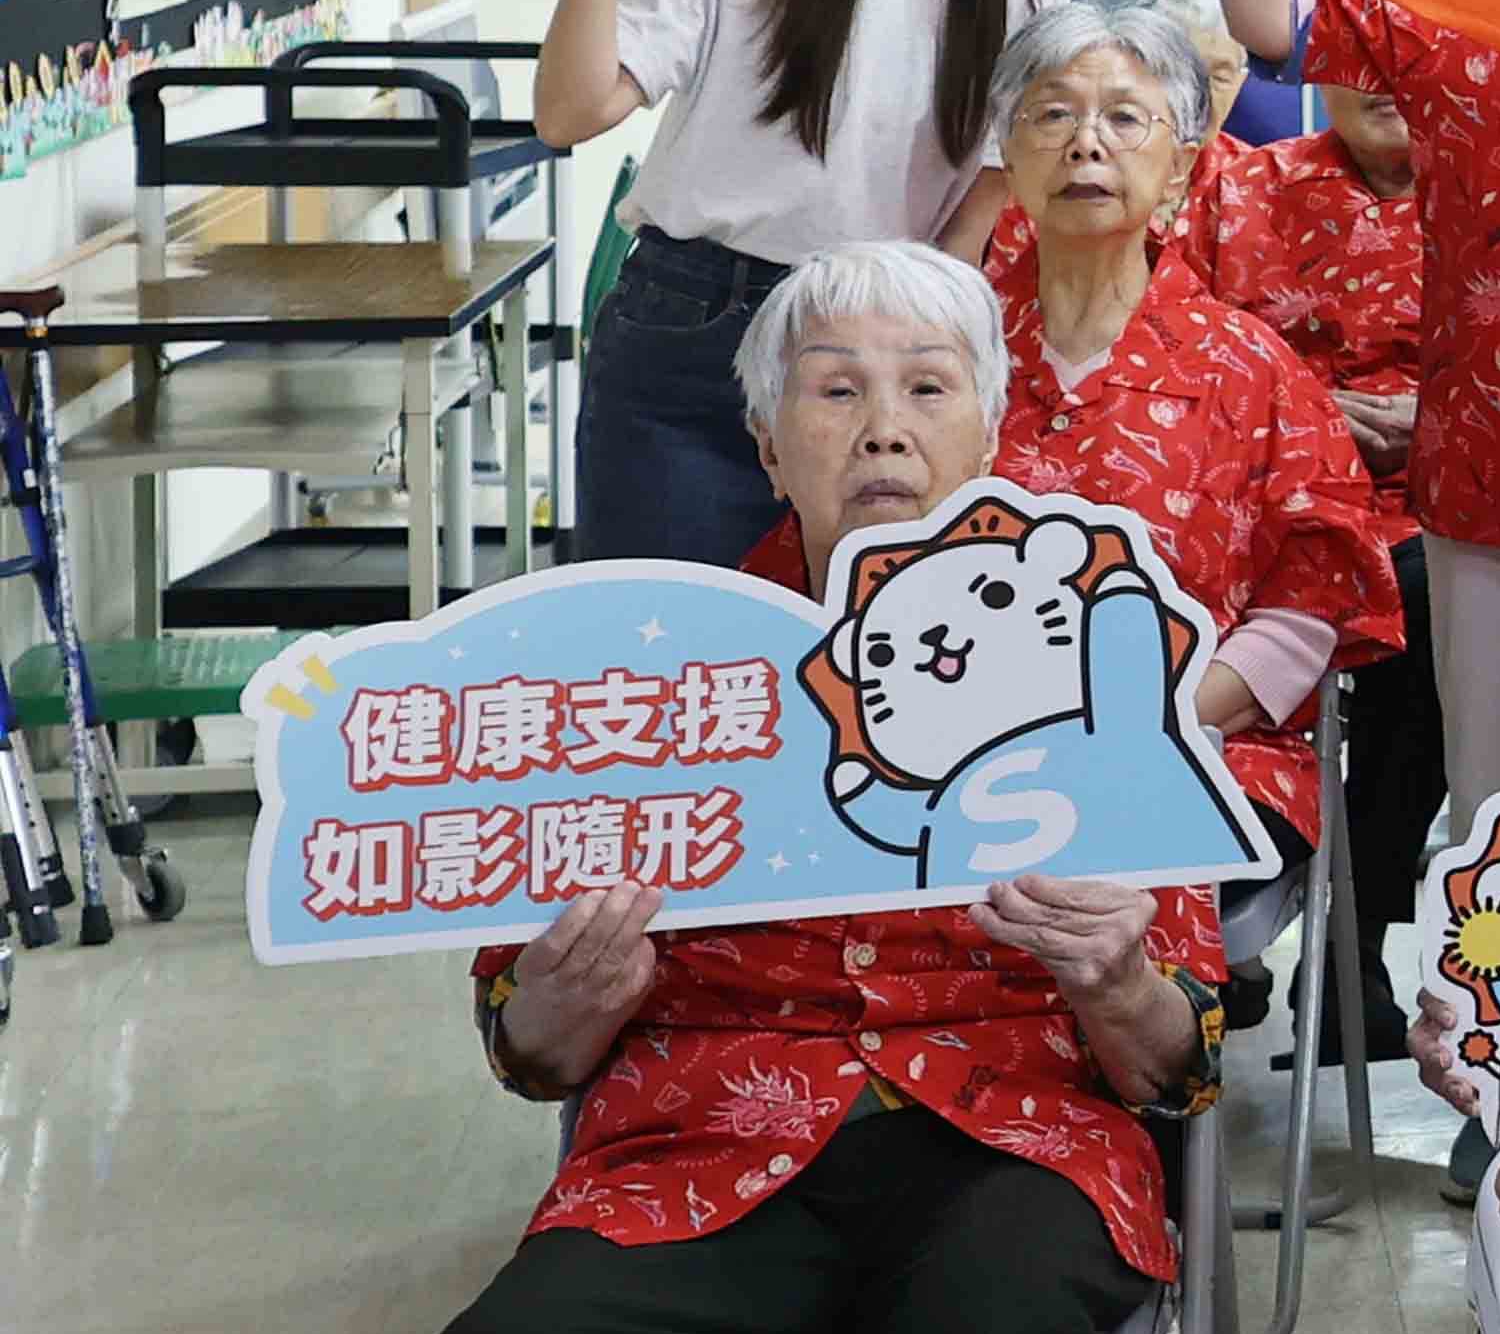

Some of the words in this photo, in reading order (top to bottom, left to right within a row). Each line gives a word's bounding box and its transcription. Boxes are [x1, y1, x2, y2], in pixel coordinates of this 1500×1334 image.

[341, 659, 783, 789] 健康支援
[303, 787, 746, 918] 如影隨形
[959, 747, 1079, 873] S
